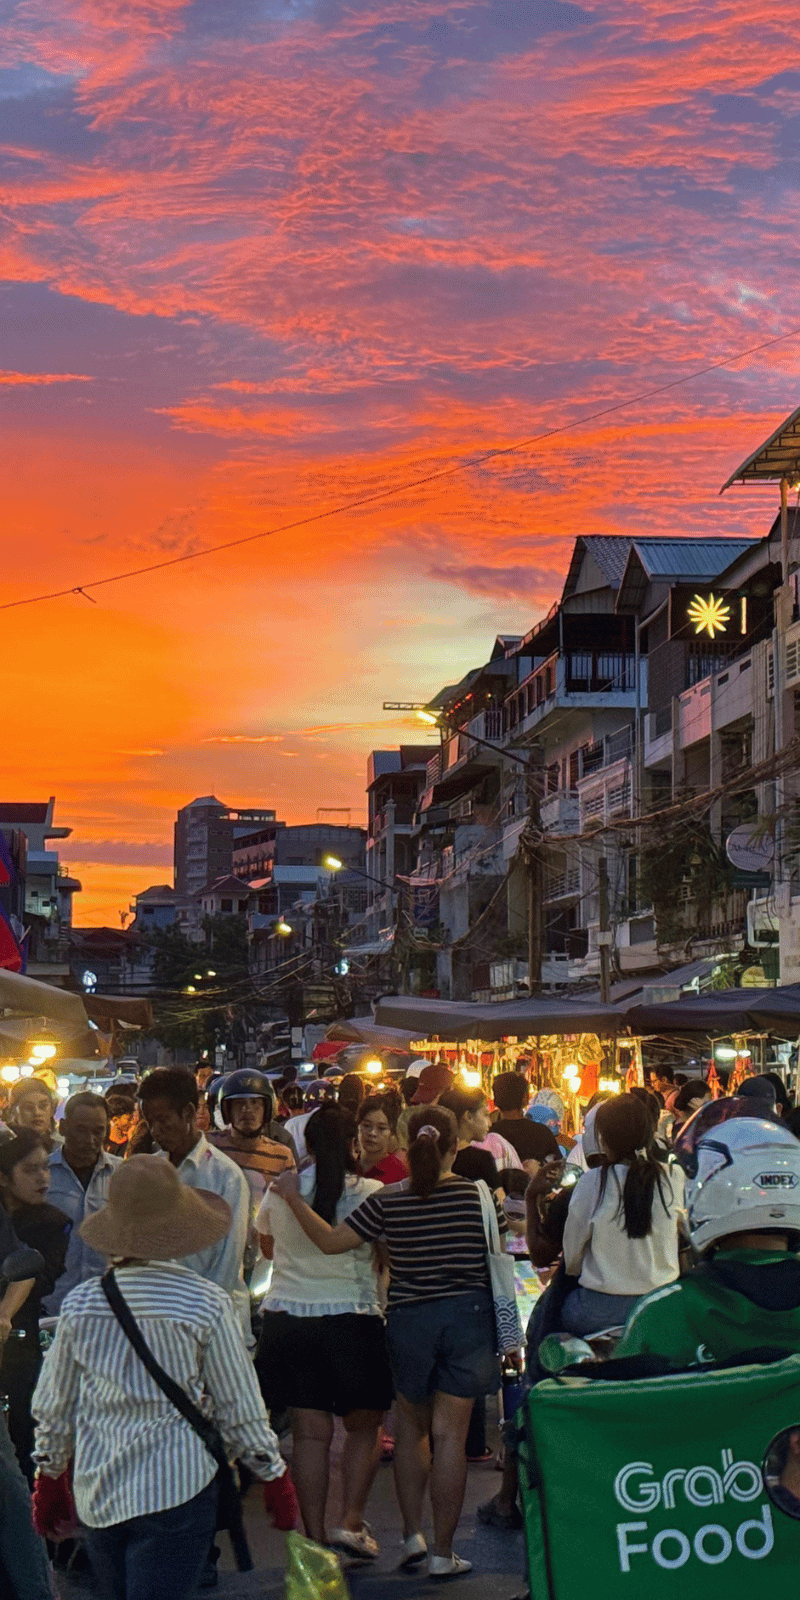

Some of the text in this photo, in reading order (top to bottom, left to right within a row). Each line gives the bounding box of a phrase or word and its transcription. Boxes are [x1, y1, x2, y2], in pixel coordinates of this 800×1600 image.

[760, 1174, 794, 1186] INDEX
[614, 1448, 764, 1513] Grab
[616, 1504, 774, 1572] Food
